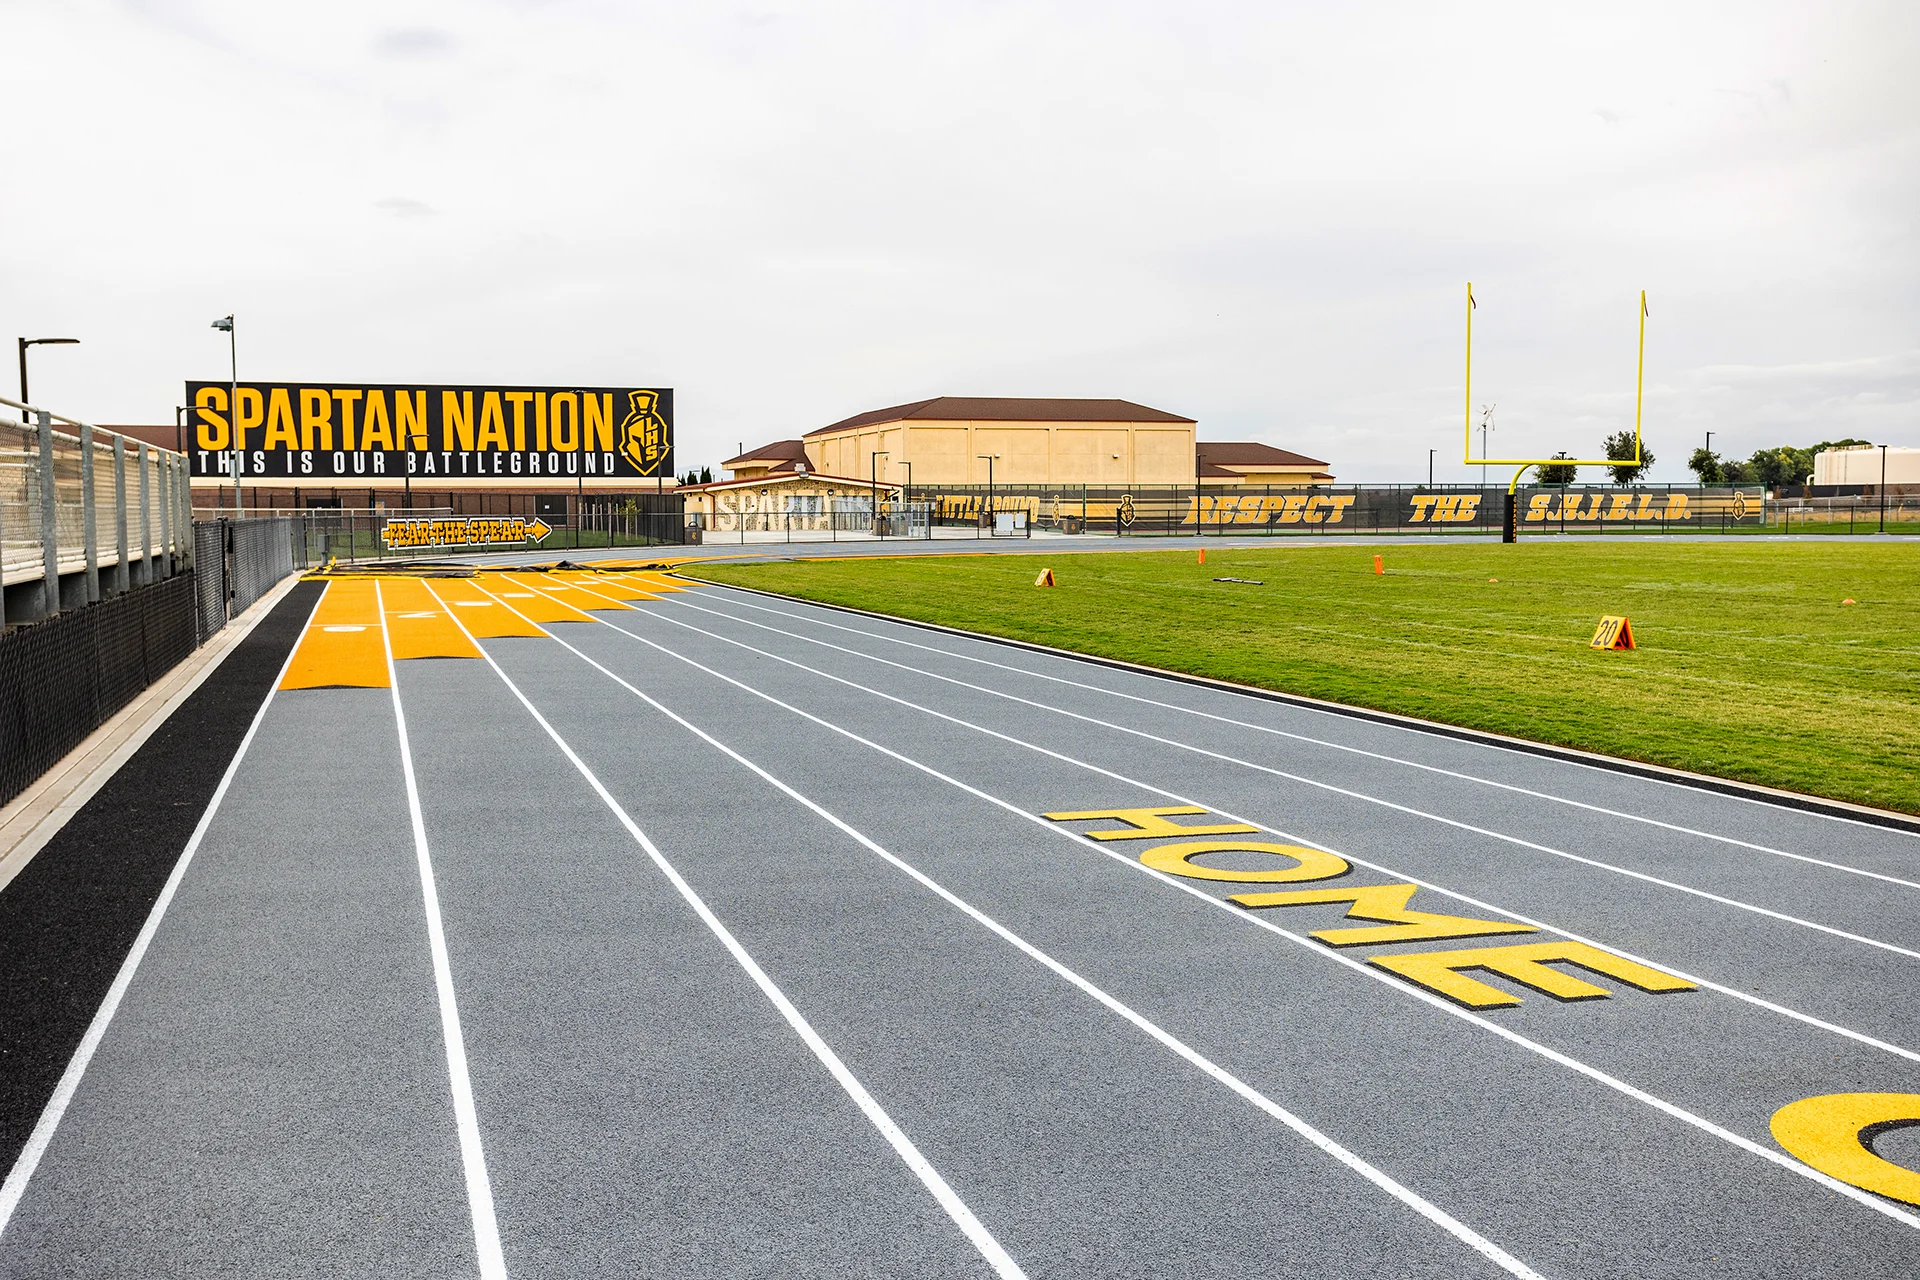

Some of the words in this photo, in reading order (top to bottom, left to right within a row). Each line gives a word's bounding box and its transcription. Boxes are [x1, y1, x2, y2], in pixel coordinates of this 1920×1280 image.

[195, 387, 428, 451] SPARTAN
[442, 390, 614, 452] NATION
[645, 416, 658, 462] LHS
[198, 450, 266, 474] THIS
[287, 451, 313, 474] IS
[333, 451, 385, 474] OUR
[407, 451, 615, 475] BATTLEGROUND
[1181, 495, 1356, 524] RESPECT
[1408, 495, 1482, 522] THE
[388, 521, 431, 547] FEAR
[431, 520, 468, 546] THE
[469, 519, 526, 544] SPEAR
[1592, 620, 1618, 646] 20
[1041, 805, 1699, 1011] HOME
